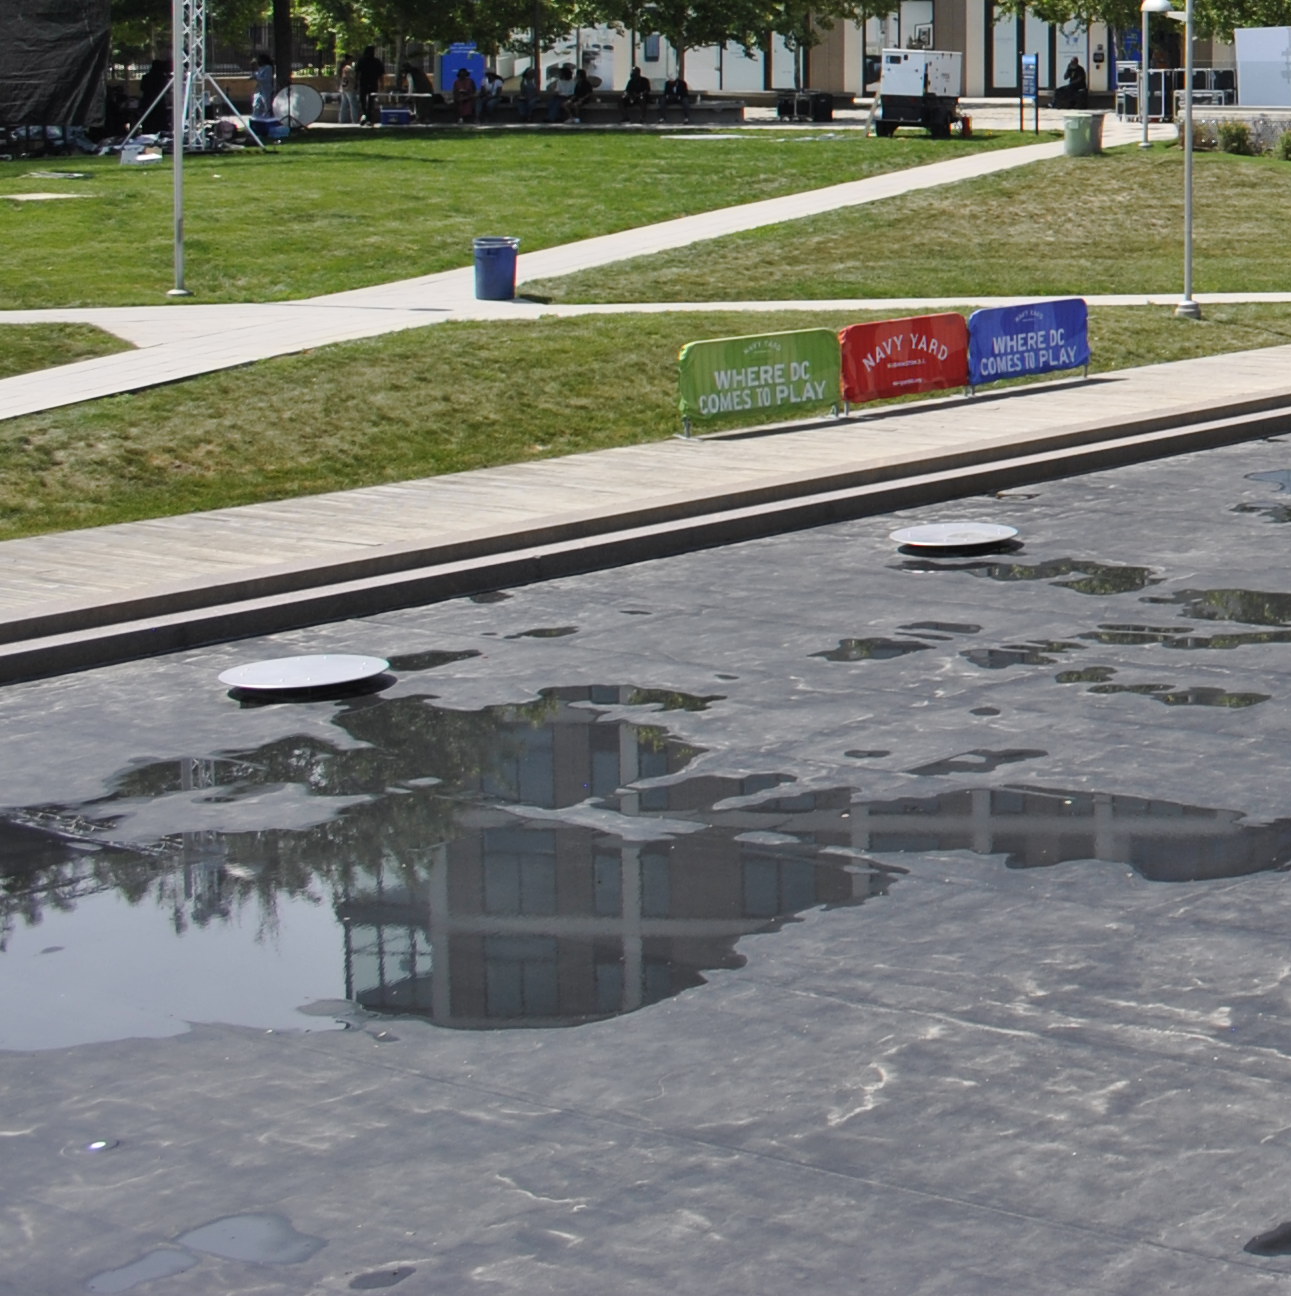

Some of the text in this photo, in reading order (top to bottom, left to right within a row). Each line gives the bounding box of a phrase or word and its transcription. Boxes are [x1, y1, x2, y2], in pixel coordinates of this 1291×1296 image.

[862, 332, 949, 372] NAVY YARD
[992, 328, 1065, 354] WHERE DC
[714, 360, 810, 390] WHERE DC
[980, 345, 1077, 376] COMES TO PLAY
[699, 380, 827, 415] COMES TO PLAY
